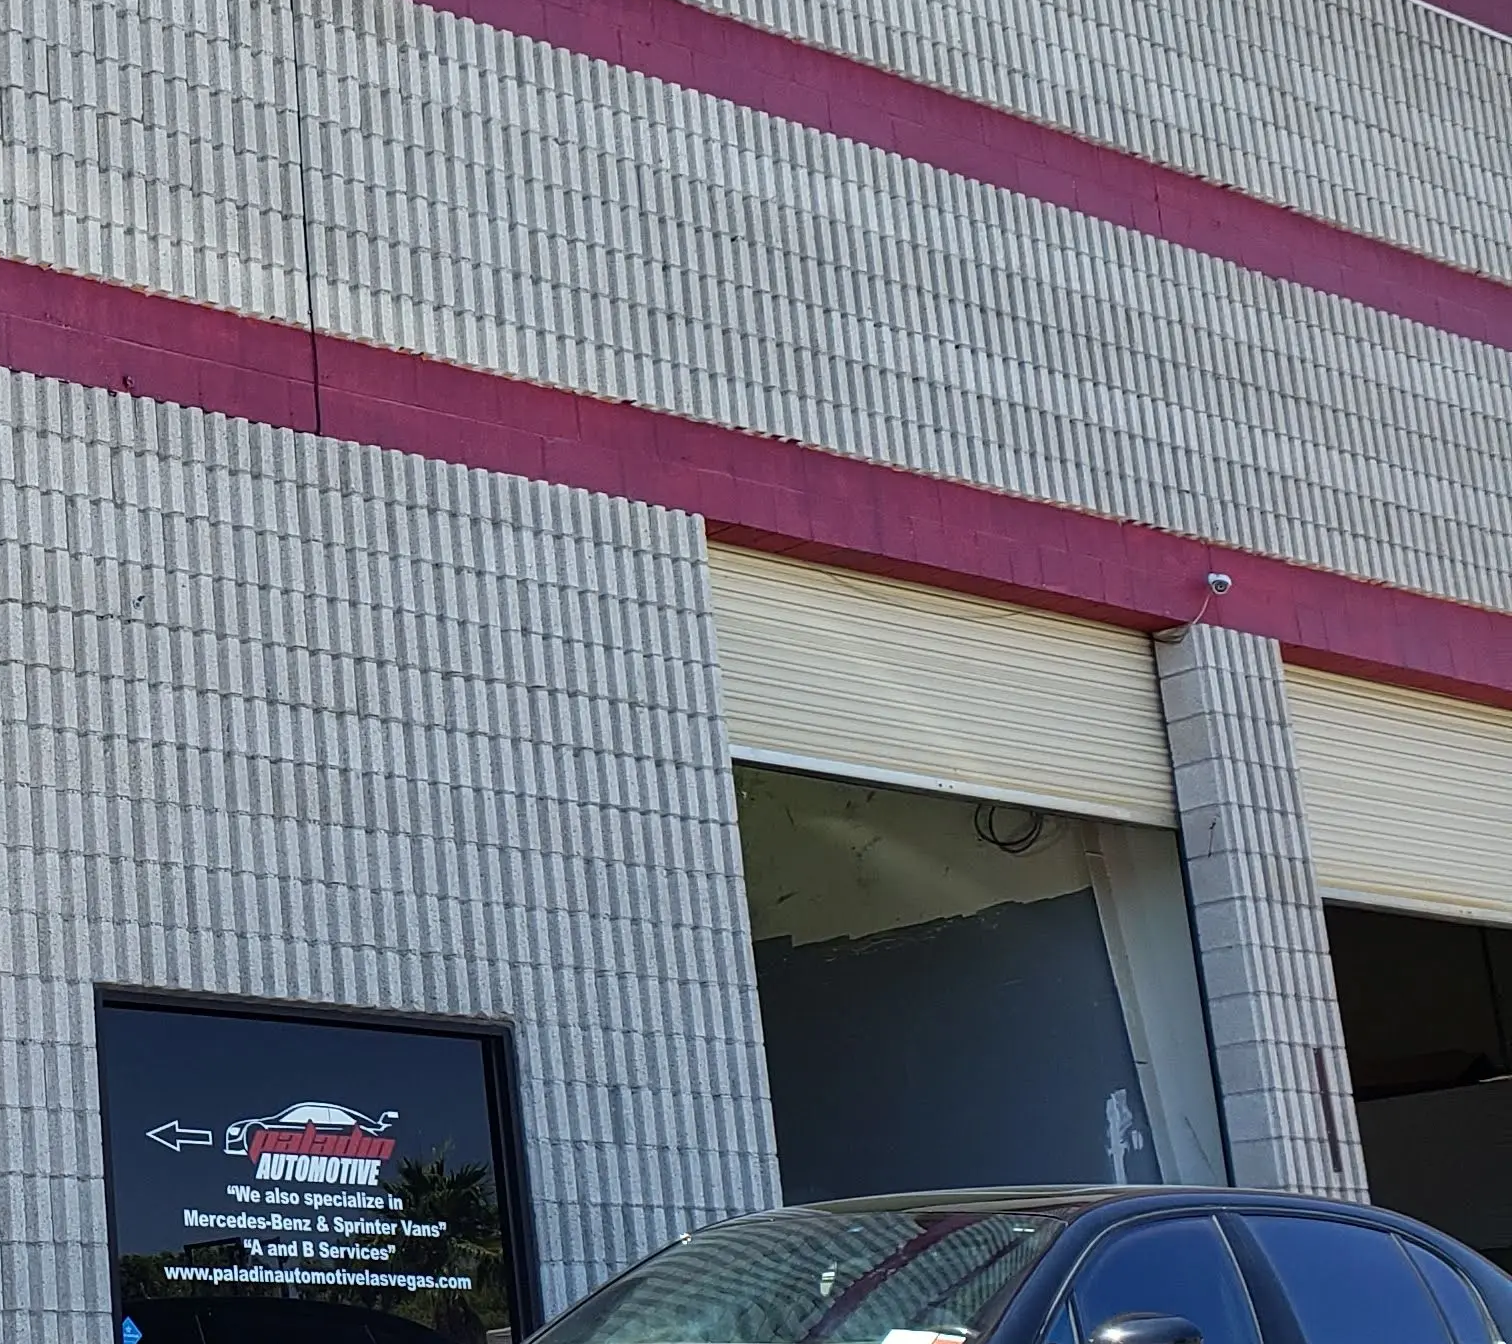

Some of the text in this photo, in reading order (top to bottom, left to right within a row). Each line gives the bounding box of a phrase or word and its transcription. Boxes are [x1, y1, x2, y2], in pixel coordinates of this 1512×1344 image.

[247, 1119, 396, 1164] paladin
[255, 1153, 381, 1186] AUTOMOTIVE
[265, 1187, 299, 1205] also
[303, 1190, 385, 1211] specialize
[388, 1194, 403, 1211] in
[184, 1209, 312, 1232] Mercedes-Benz
[317, 1216, 330, 1233] &
[333, 1217, 398, 1237] Sprinter
[267, 1240, 298, 1258] and
[302, 1241, 315, 1258] B
[164, 1263, 472, 1292] www.paladinautomotivelasvegas.com
